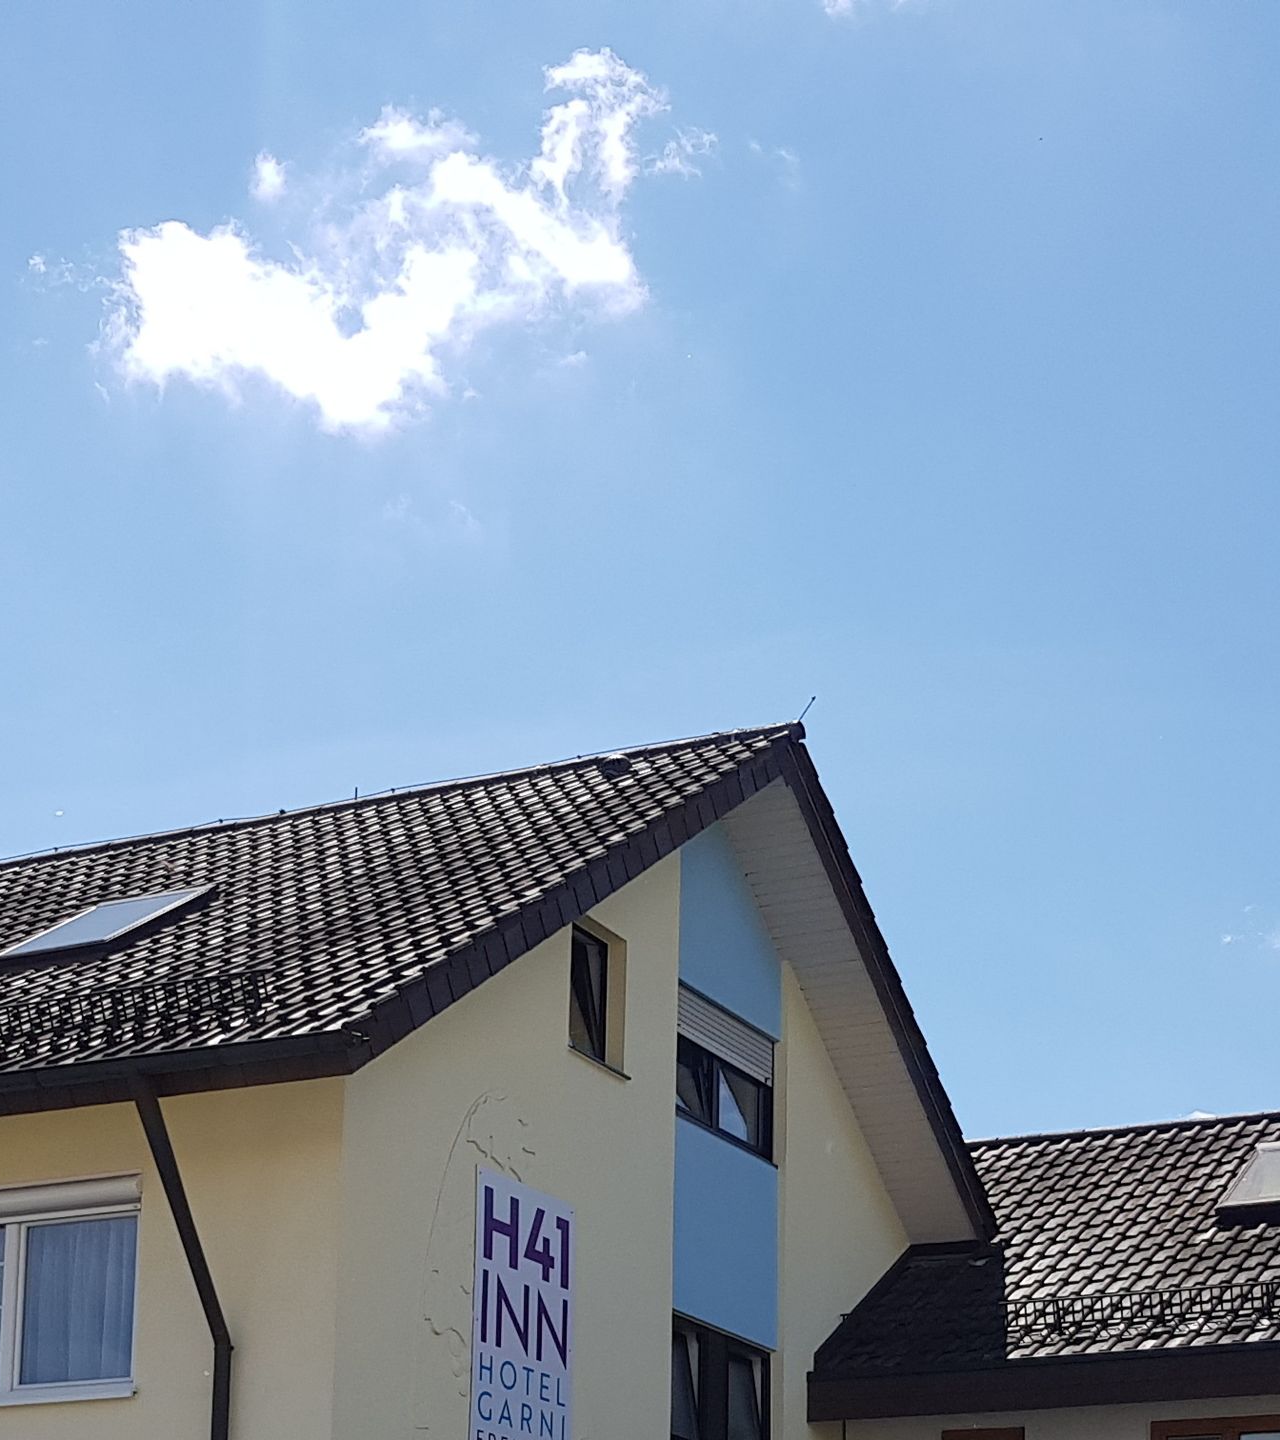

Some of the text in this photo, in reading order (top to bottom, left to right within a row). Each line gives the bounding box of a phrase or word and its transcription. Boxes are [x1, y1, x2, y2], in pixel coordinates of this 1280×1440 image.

[483, 1185, 570, 1291] H41
[480, 1268, 569, 1371] INN
[479, 1351, 566, 1408] HOTEL
